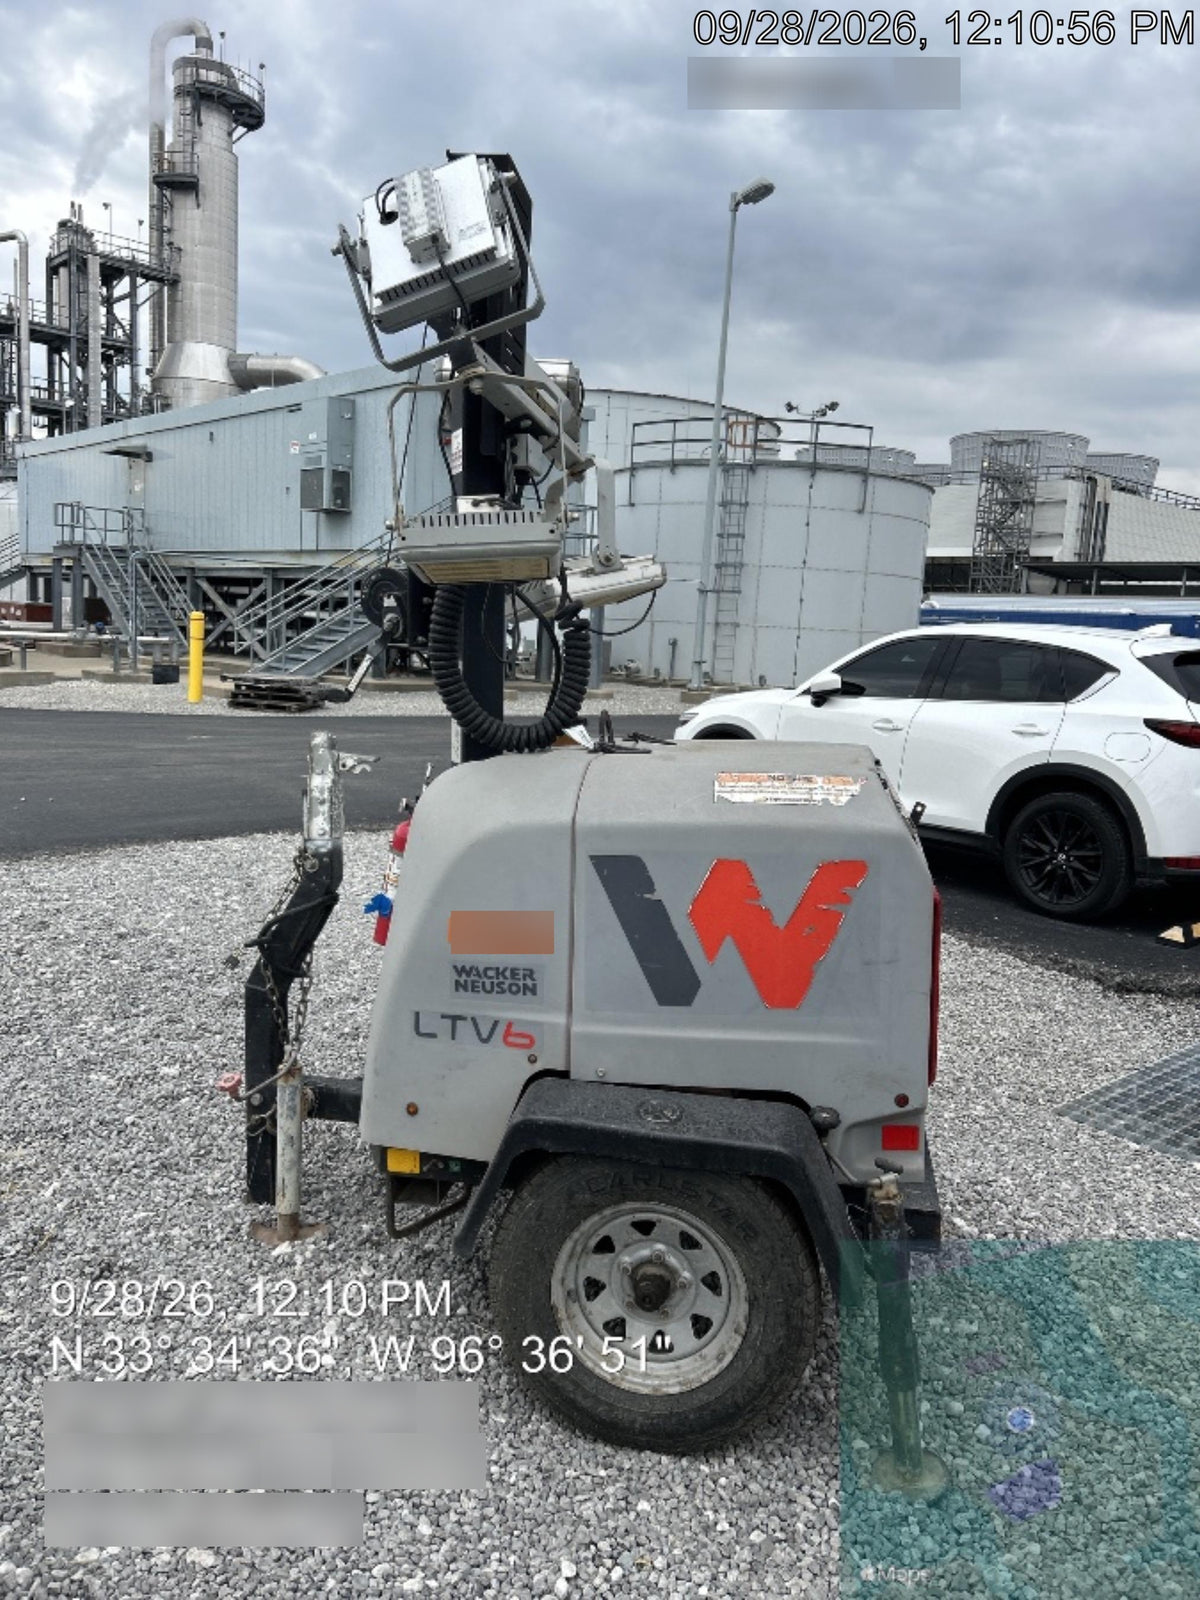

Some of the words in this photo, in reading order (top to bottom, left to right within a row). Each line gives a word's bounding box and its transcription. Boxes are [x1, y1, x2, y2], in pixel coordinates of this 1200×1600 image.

[452, 964, 537, 982] WACKER
[454, 979, 538, 996] NEUSON
[414, 1011, 536, 1050] LTV6
